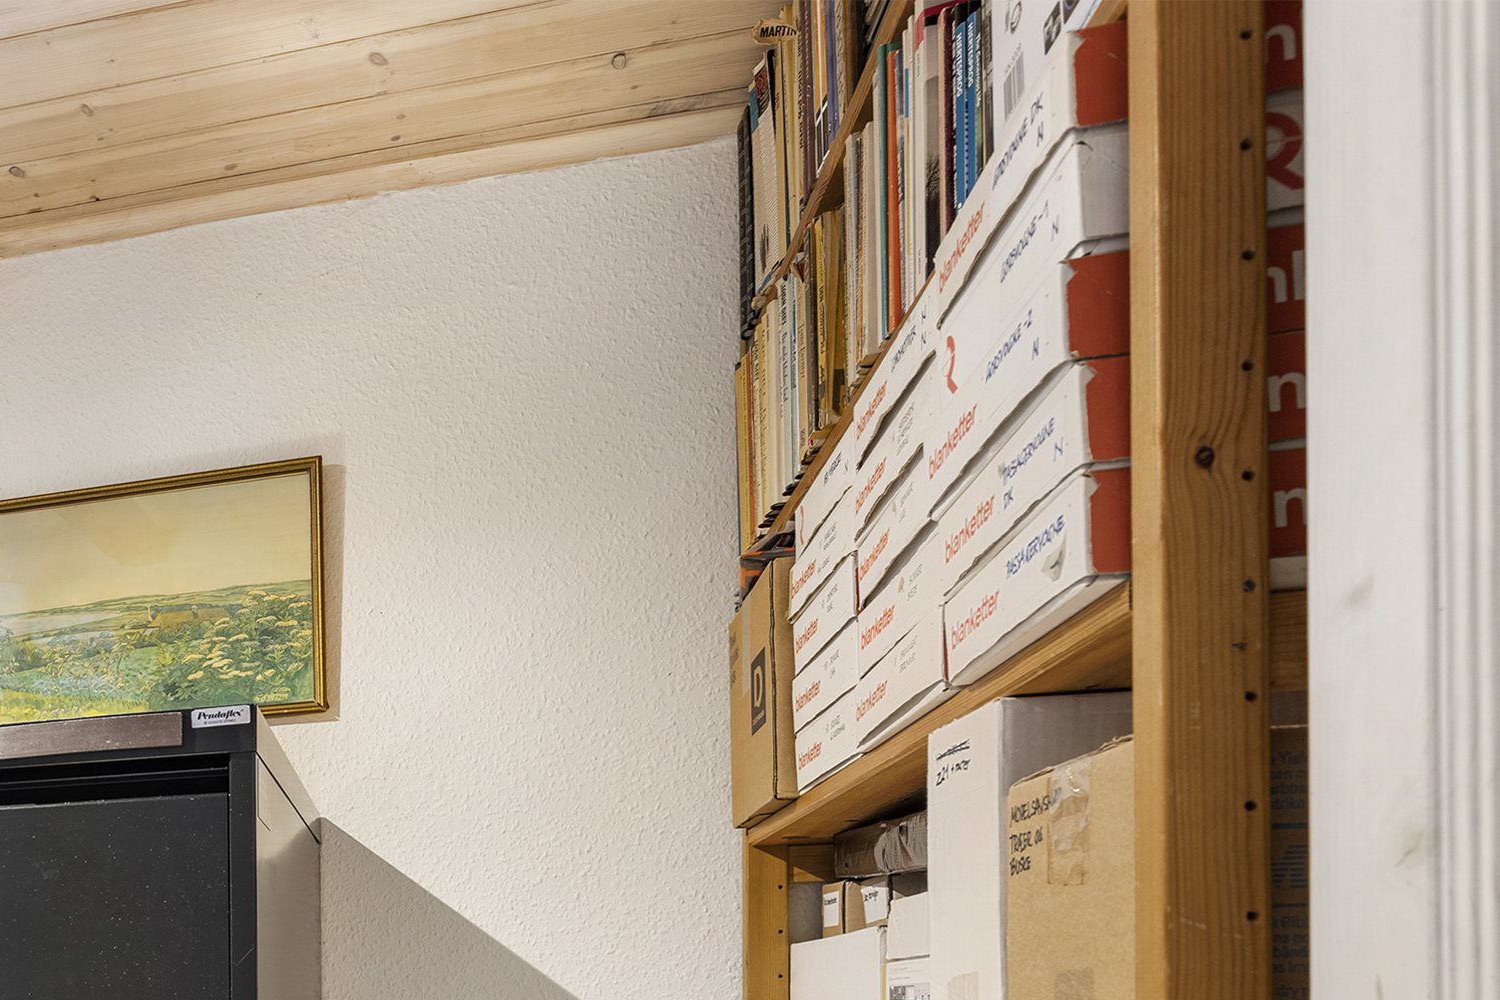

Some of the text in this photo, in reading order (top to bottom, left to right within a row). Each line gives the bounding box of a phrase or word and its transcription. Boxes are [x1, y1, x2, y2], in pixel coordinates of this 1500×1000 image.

[928, 403, 978, 480] blanketter
[945, 494, 995, 564] blanketter
[861, 604, 895, 650] blanketter
[951, 591, 1000, 650] blanketter
[197, 709, 244, 720] Pendaflex
